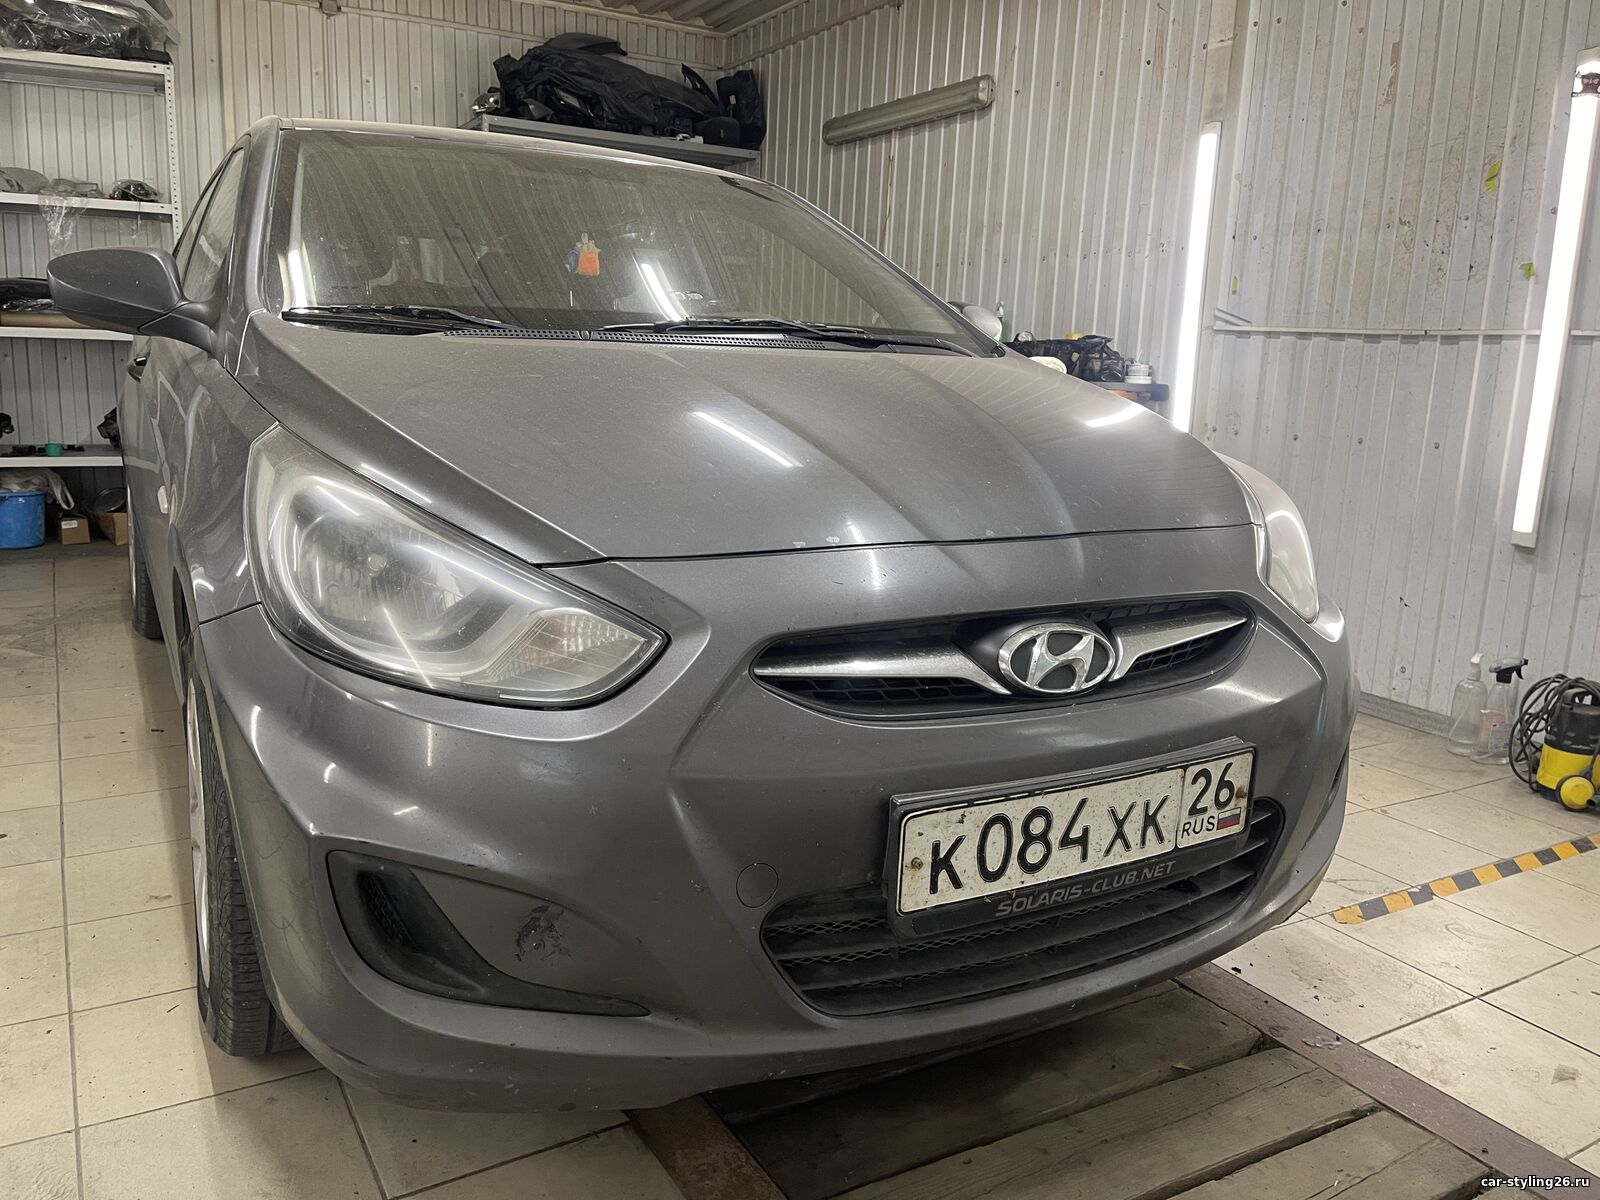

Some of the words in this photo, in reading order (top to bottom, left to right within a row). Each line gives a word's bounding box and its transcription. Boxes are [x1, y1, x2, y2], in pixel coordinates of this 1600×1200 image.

[1188, 762, 1236, 817] 26
[1181, 815, 1216, 838] RUS
[994, 860, 1177, 917] SOLARIS-CLUB.NET
